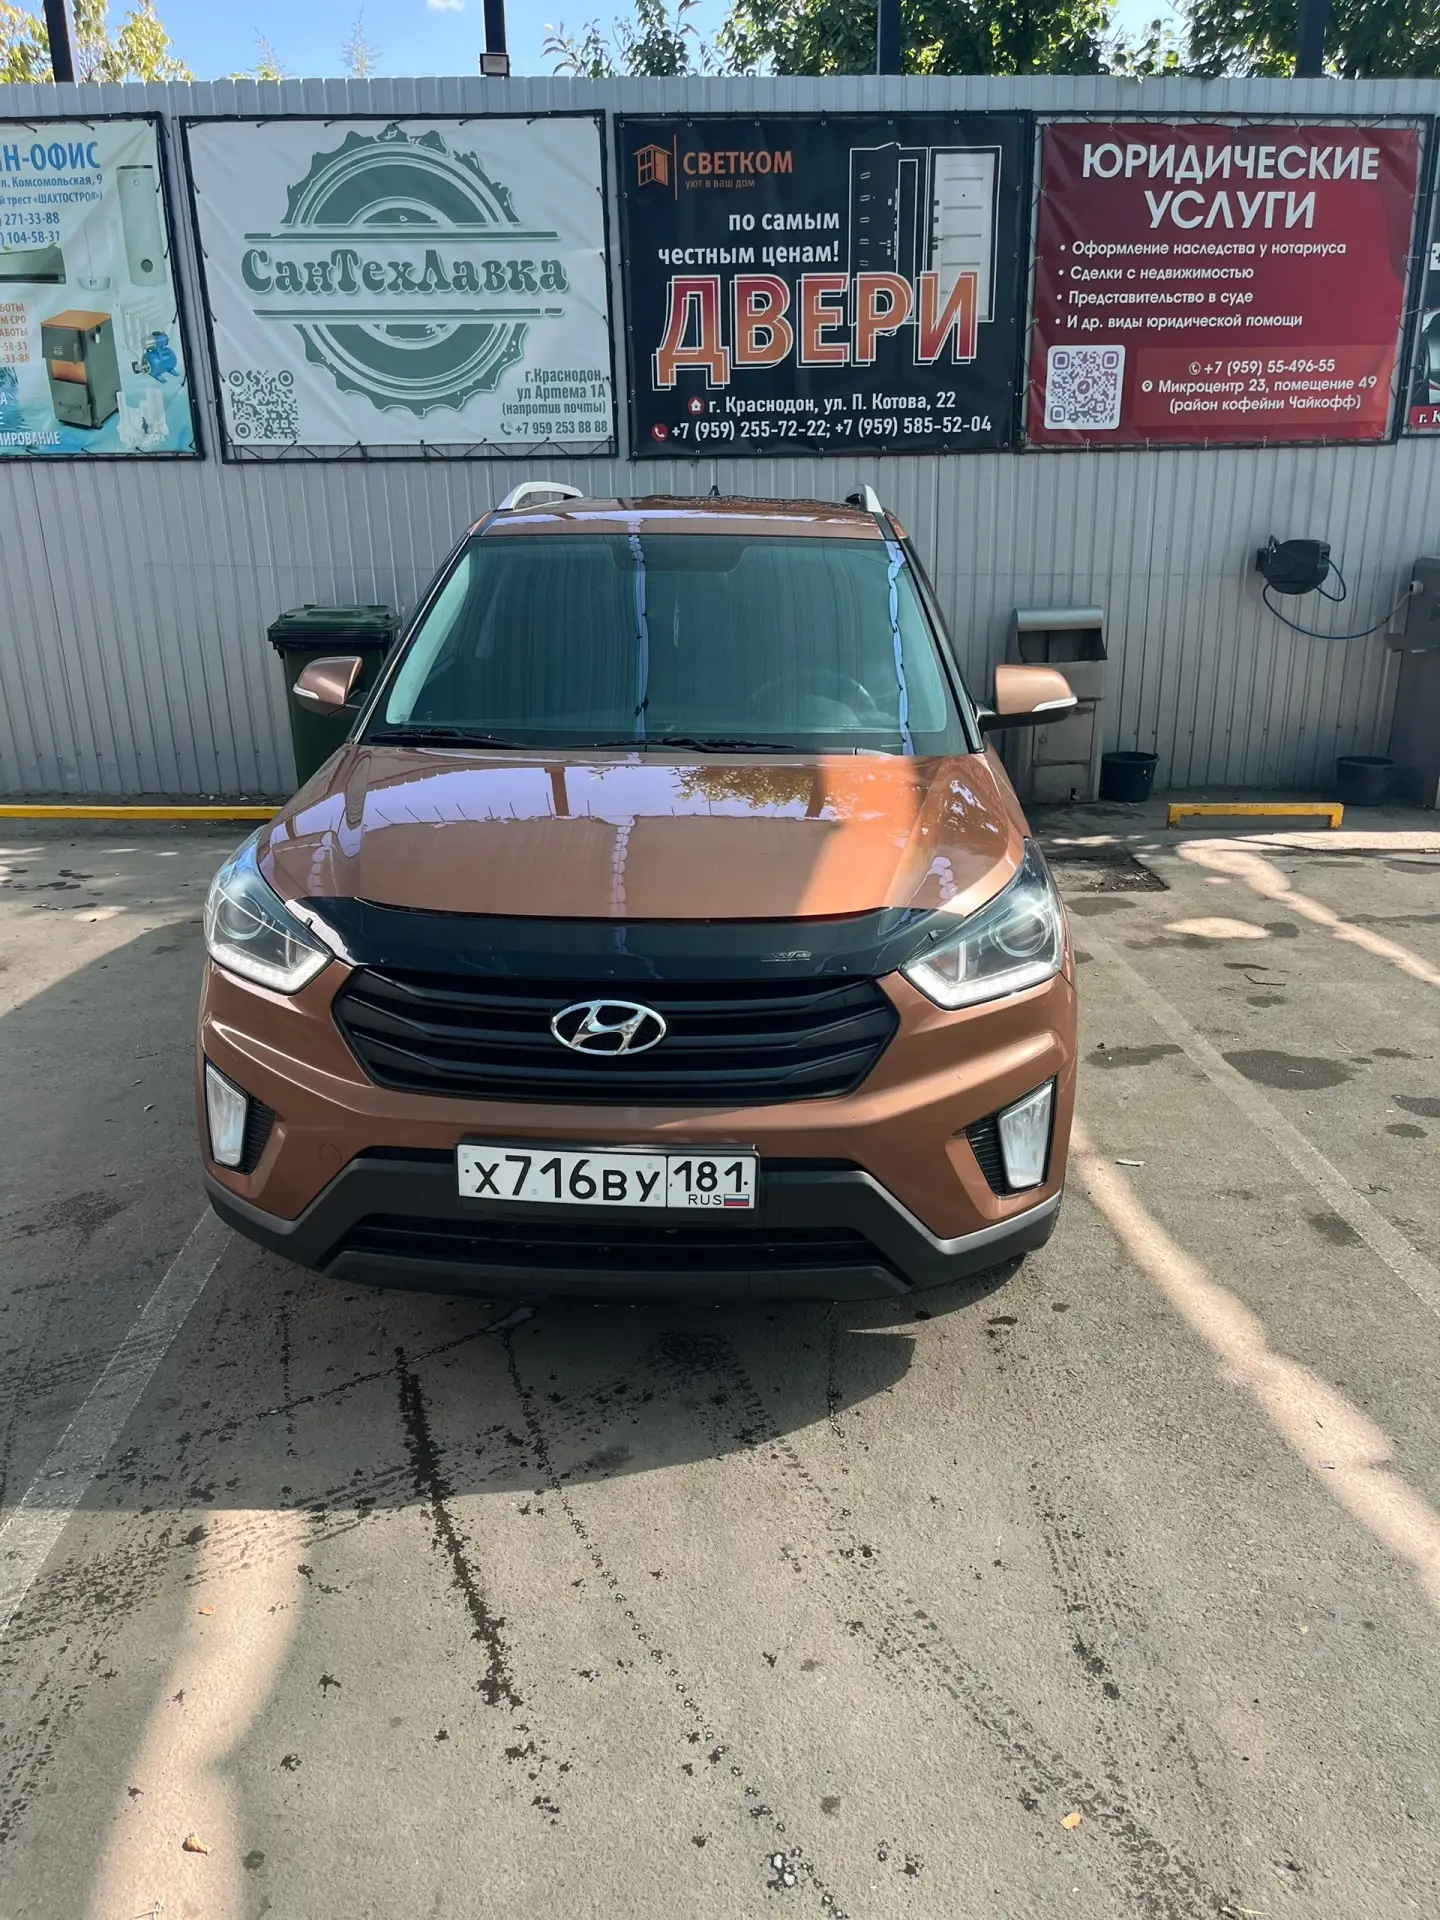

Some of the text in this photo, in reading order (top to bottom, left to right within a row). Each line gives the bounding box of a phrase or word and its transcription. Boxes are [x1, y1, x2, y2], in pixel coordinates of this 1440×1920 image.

[0, 141, 101, 171] Н-ОФИС
[682, 151, 793, 175] СВЕТКОМ
[1082, 143, 1381, 185] ЮРИДИЧЕСКИЕ
[12, 176, 95, 188] Комсомольская,
[96, 173, 103, 185] 9
[685, 178, 755, 190] уют в ваш дом
[7, 195, 32, 207] трест
[1143, 190, 1316, 230] УСЛУГИ
[4, 212, 60, 226] 271-33-88
[729, 212, 840, 231] по самым
[7, 230, 60, 244] 104-58-31
[658, 240, 839, 266] честным ценам!
[1072, 240, 1347, 258] Оформление наследства у нотариуса
[241, 248, 569, 294] СанТехЛавка
[1070, 266, 1254, 282] Сделки с недвижимостью
[1068, 290, 1254, 307] Представительство в суде
[10, 315, 27, 325] СРО
[1067, 313, 1303, 332] И др. виды юридической помощи
[651, 271, 979, 391] ДВЕРИ
[525, 368, 605, 385] г.Краснодон,
[1204, 359, 1335, 376] +7 (959) 55-496-55
[517, 383, 606, 402] ул Артема 1А
[1158, 375, 1378, 396] Микроцентр 23, помещение 49
[502, 400, 606, 416] (напротив почты)
[708, 391, 956, 416] г. Краснодон, ул. П. Котова, 22
[1169, 393, 1362, 414] (район кофейни Чайкофф)
[515, 420, 608, 434] +7 959 253 88 88
[671, 415, 992, 442] +7 (959) 255-72-22; +7 (959) 585-52-04
[474, 1154, 743, 1202] Х716ВУ 181
[688, 1194, 722, 1206] RUS
